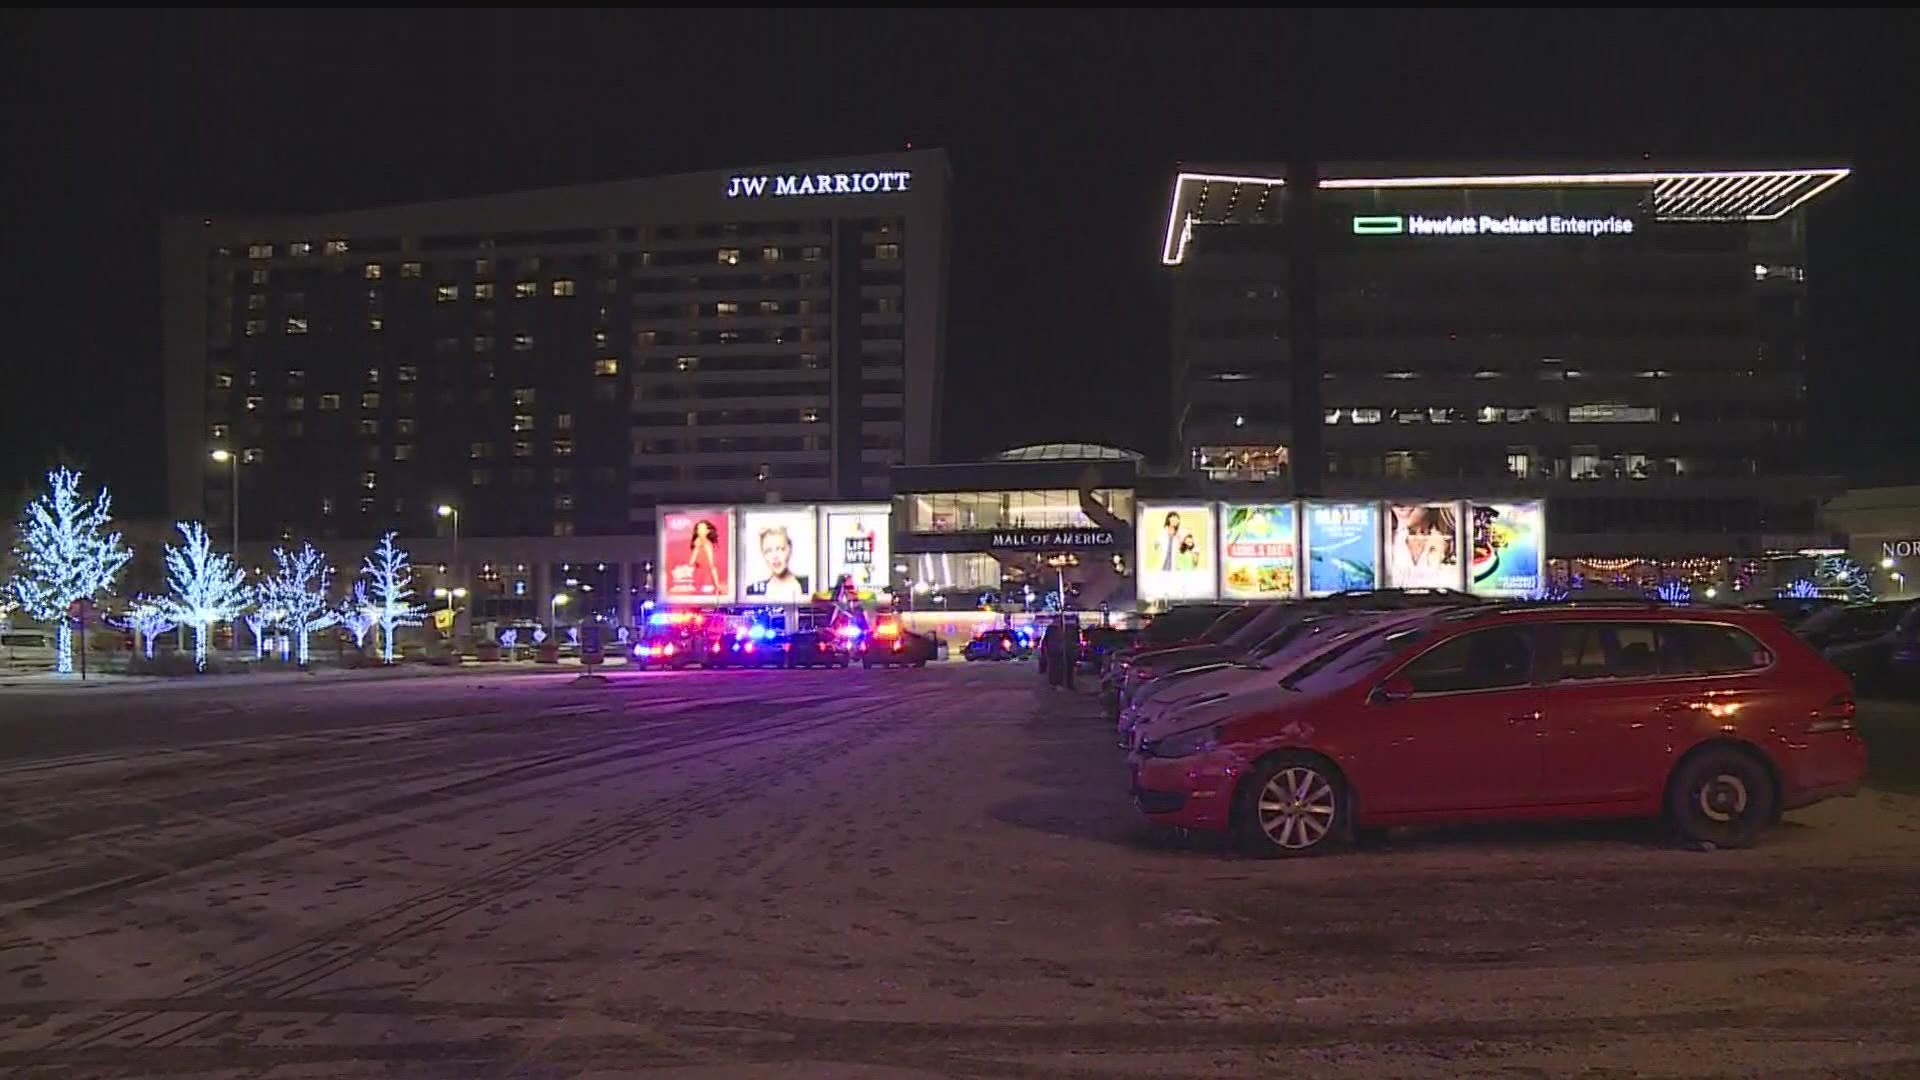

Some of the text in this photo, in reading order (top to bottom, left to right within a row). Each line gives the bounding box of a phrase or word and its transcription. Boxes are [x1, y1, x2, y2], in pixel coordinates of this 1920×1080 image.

[728, 172, 909, 197] JW MARRIOTT
[1409, 216, 1633, 236] Hewlett Packard Enterprise
[993, 533, 1113, 546] MALL OF AMERICA
